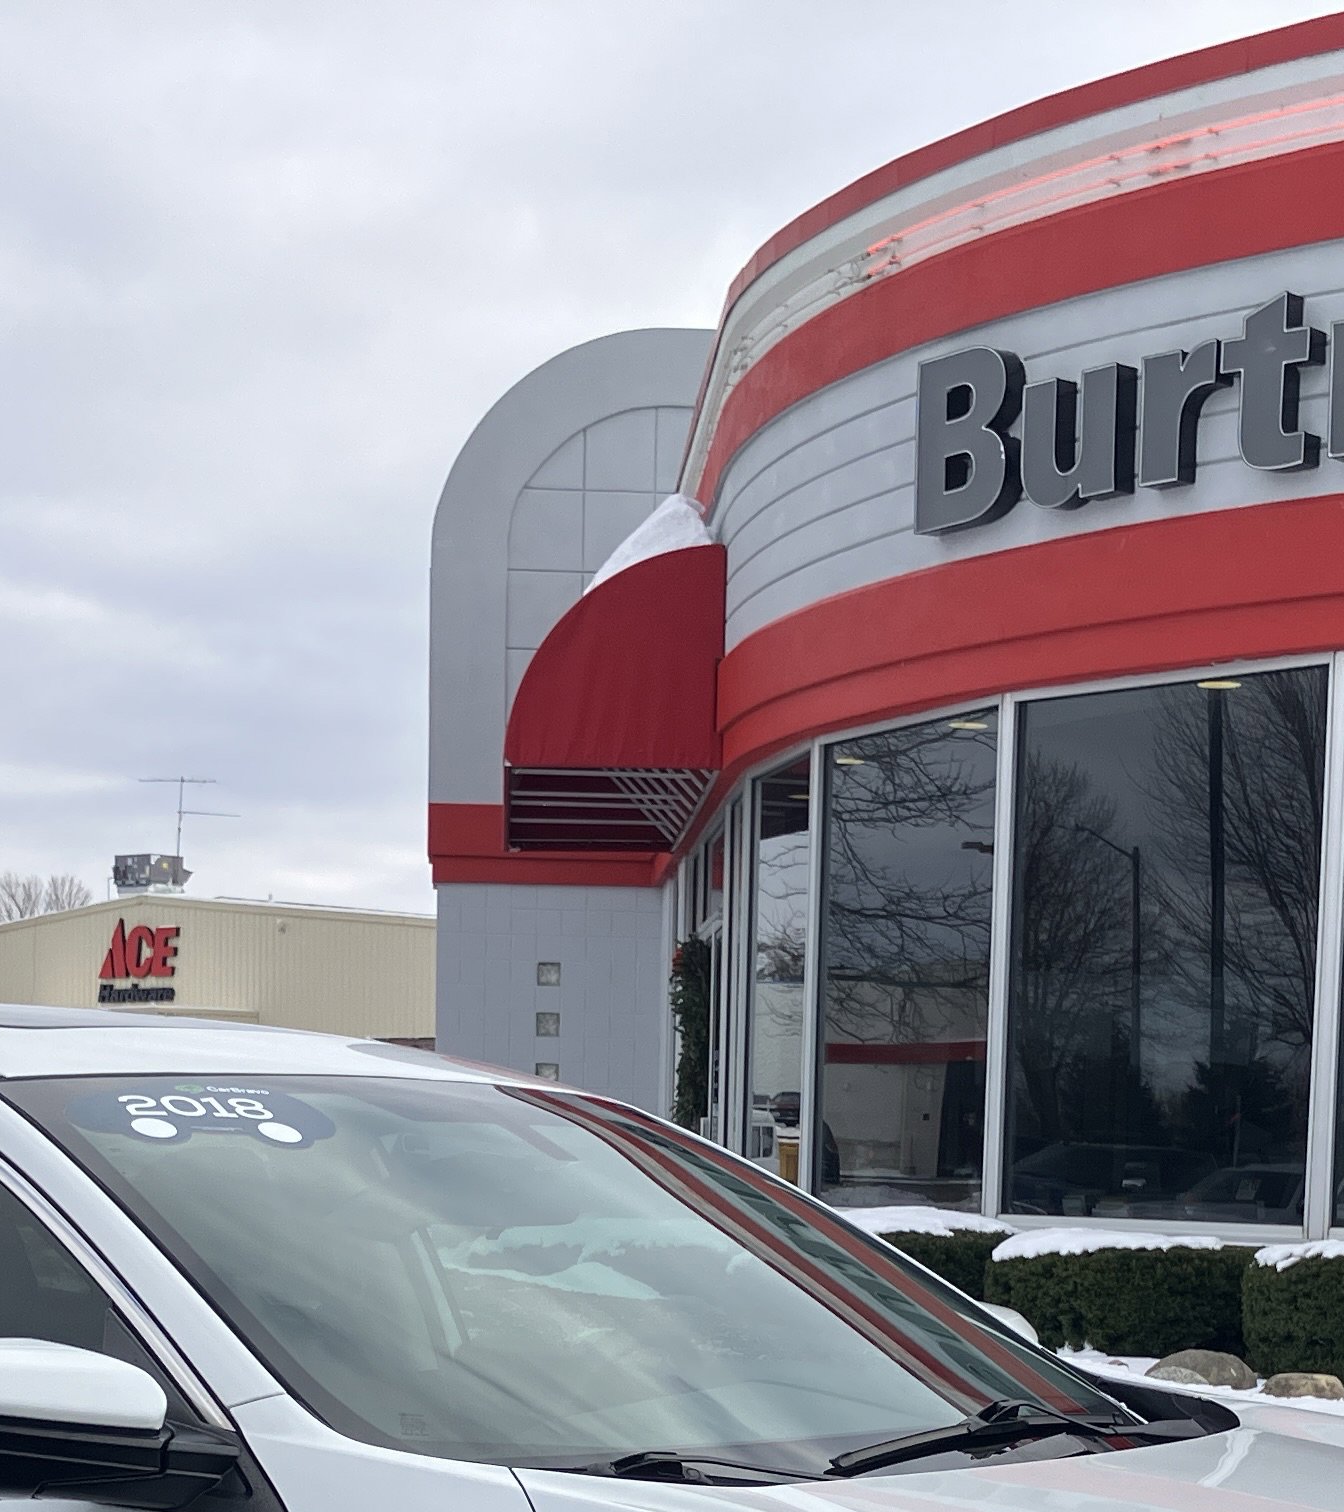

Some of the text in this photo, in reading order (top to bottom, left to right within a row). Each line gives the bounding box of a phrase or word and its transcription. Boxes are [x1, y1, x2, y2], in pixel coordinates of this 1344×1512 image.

[98, 918, 180, 979] ACE
[98, 983, 175, 1003] Hardware
[117, 1094, 274, 1120] 2018
